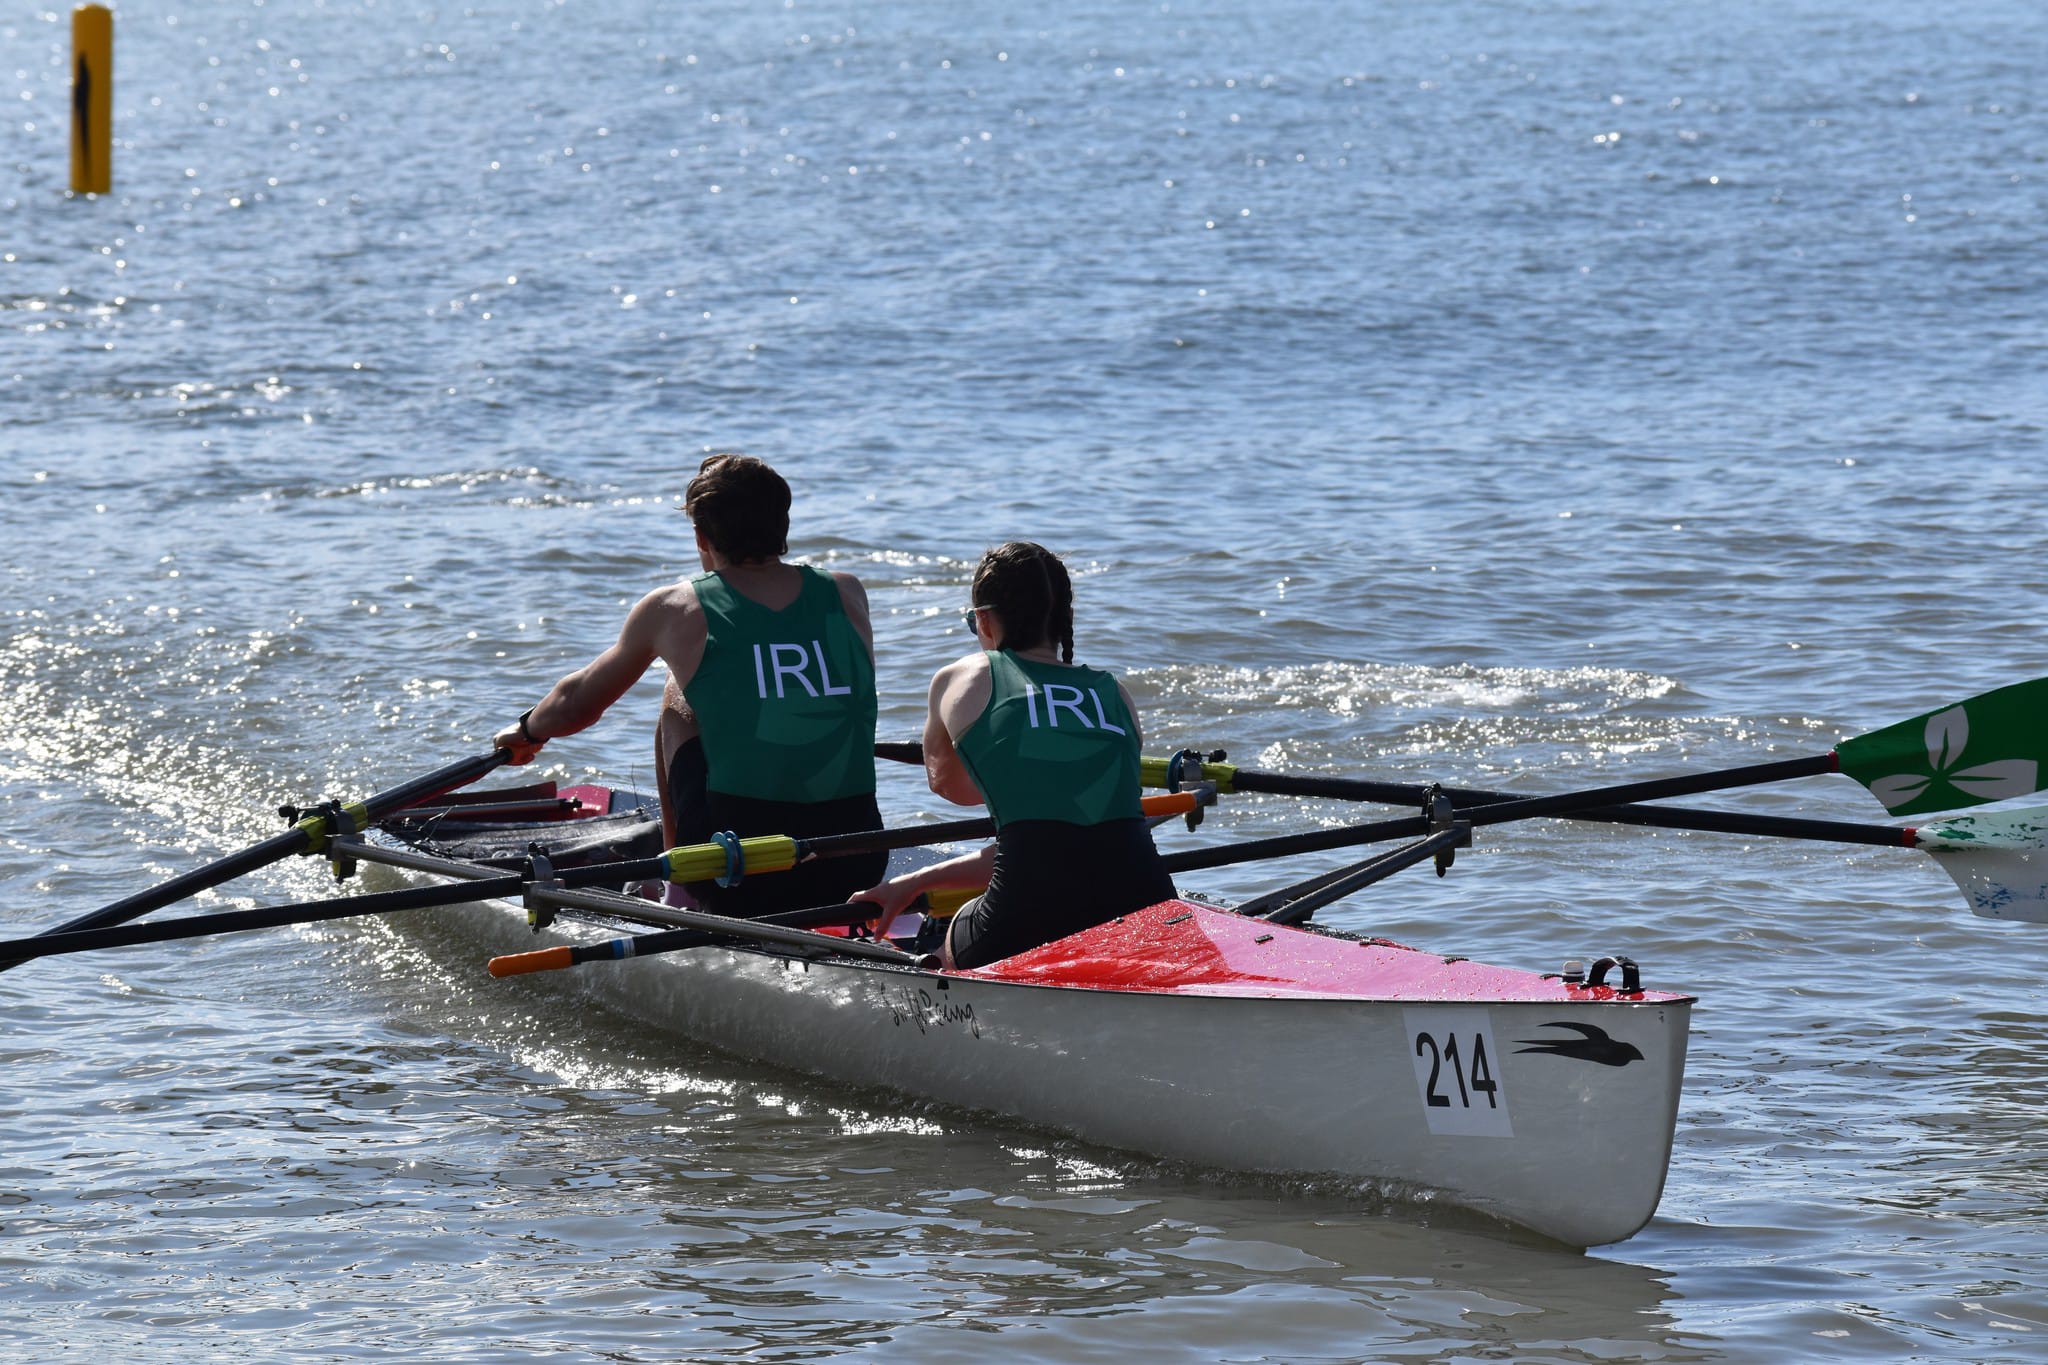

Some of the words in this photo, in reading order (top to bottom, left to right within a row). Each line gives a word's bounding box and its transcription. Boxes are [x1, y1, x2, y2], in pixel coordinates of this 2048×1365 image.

[753, 640, 851, 699] IRL
[1025, 683, 1126, 736] IRL
[1416, 1032, 1498, 1109] 214
